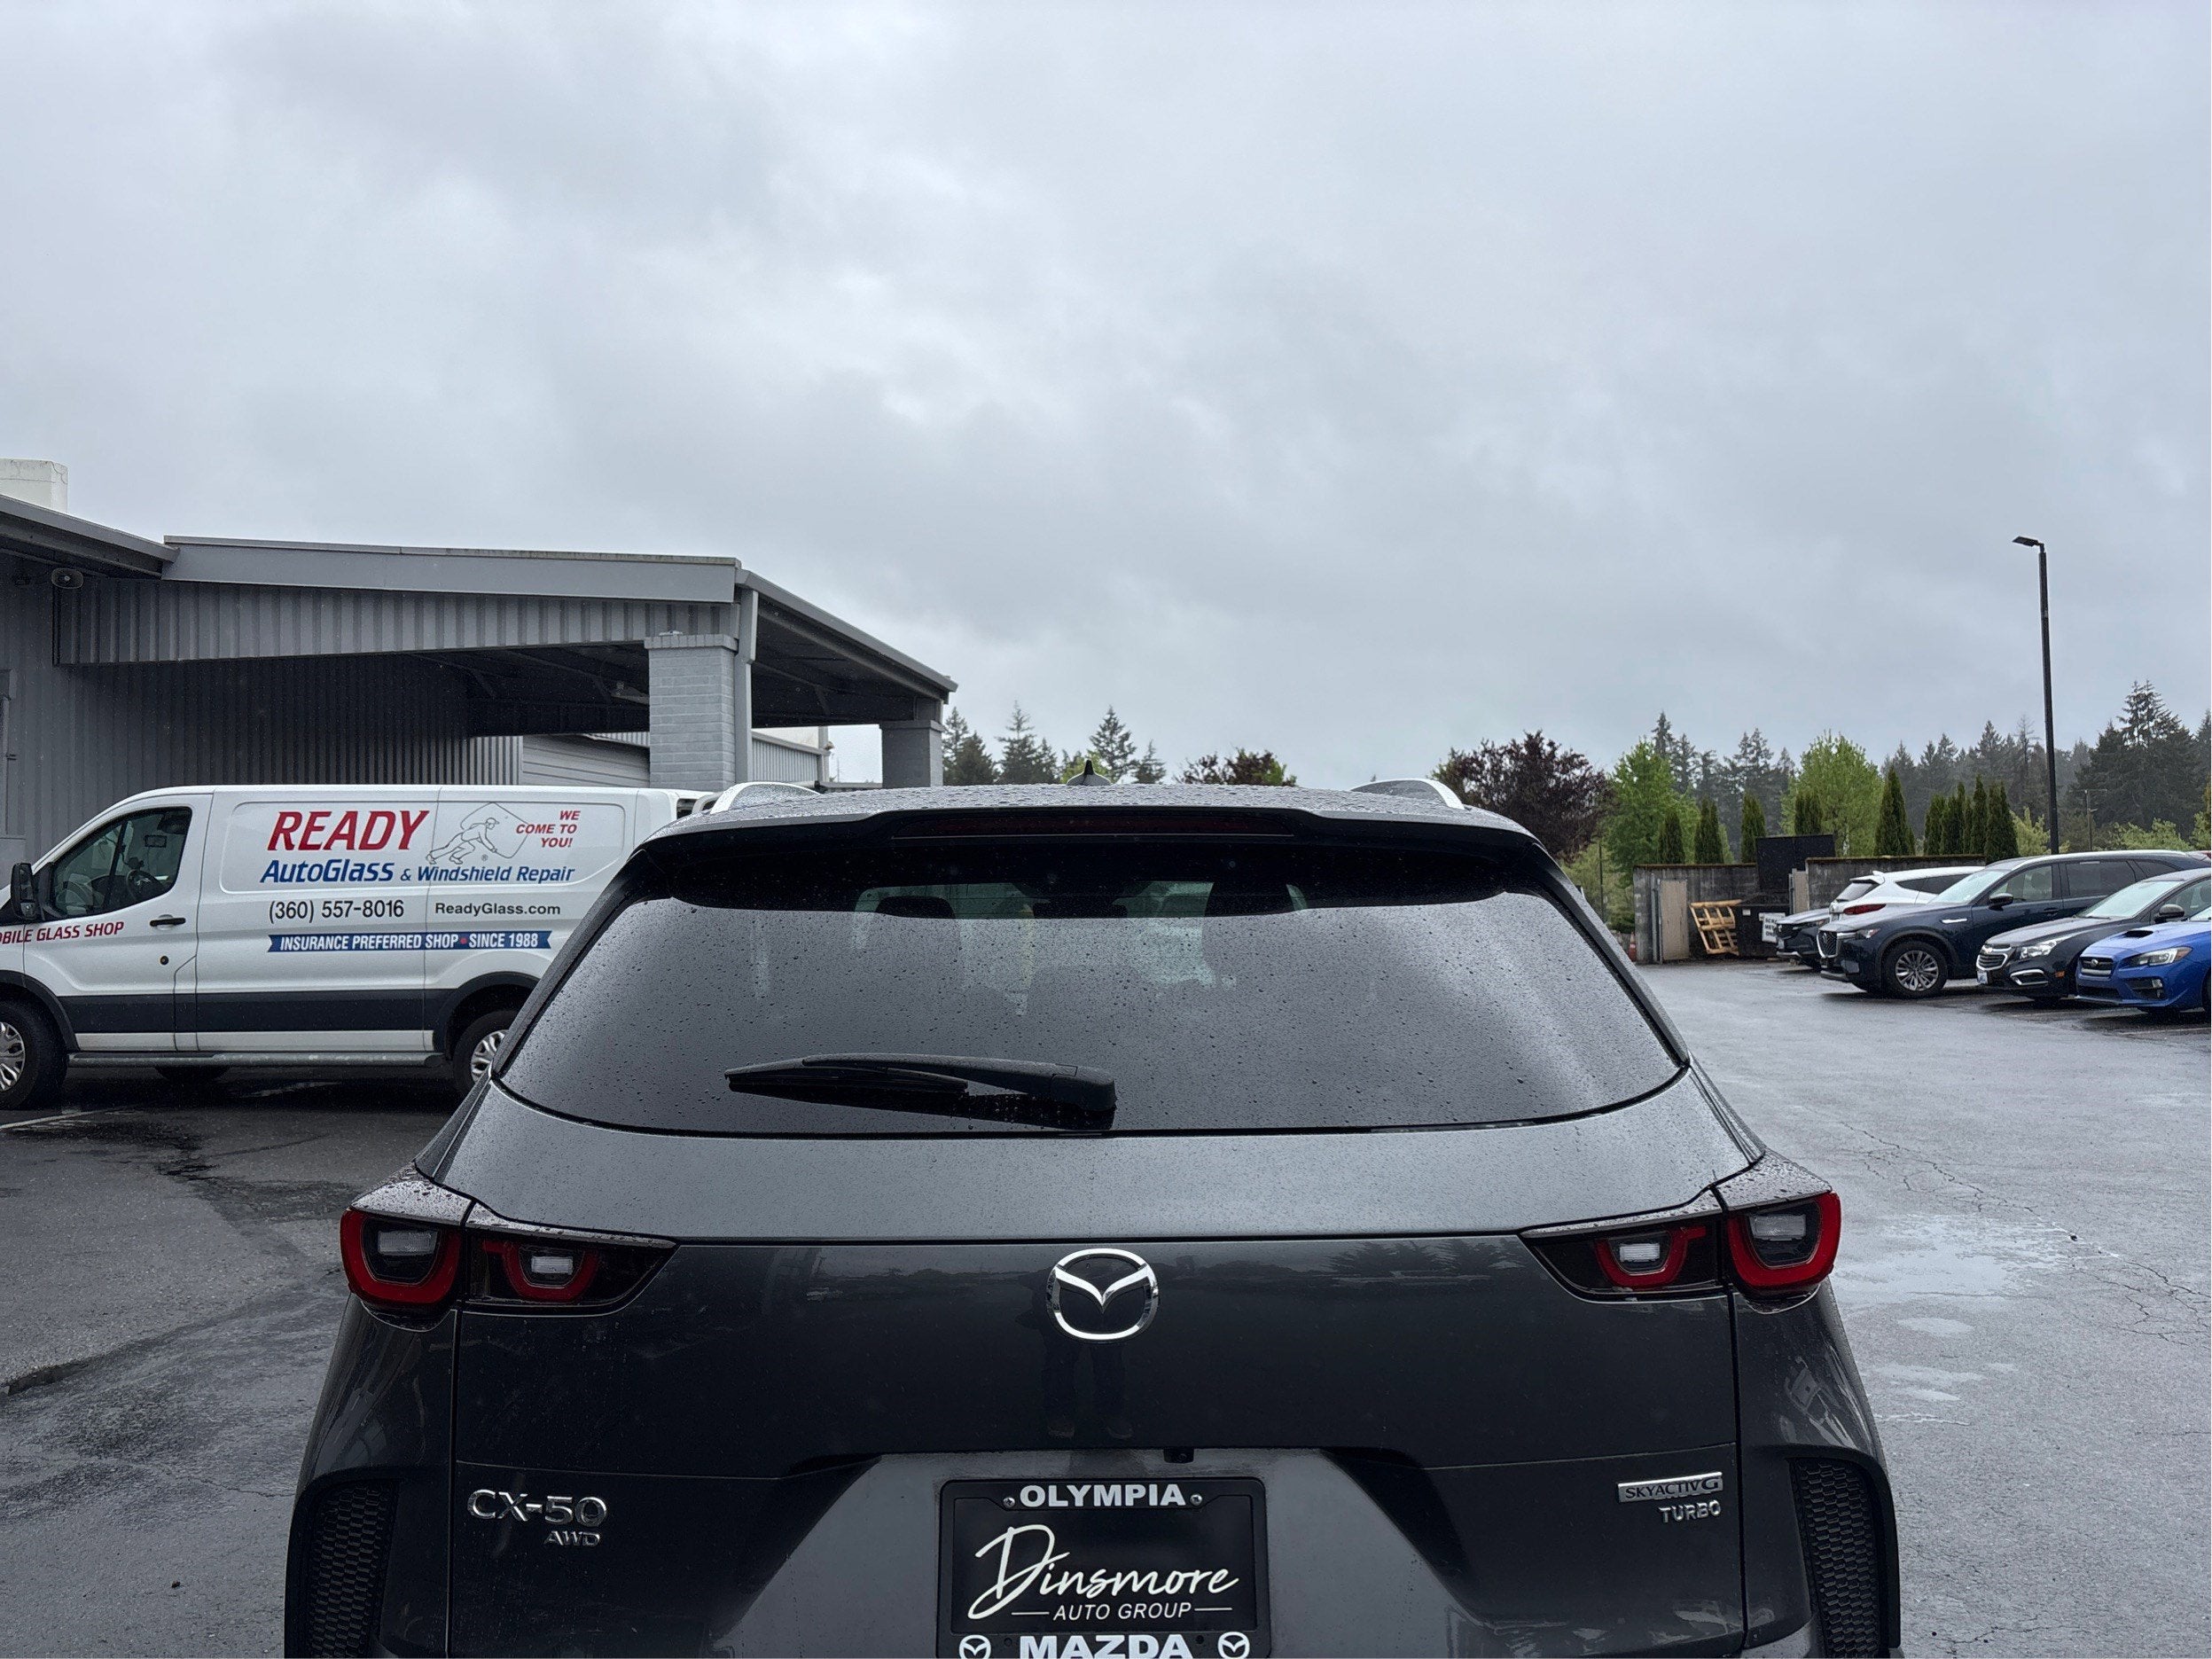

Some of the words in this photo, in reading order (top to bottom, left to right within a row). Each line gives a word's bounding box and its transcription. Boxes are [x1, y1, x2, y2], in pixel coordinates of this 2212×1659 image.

[559, 810, 580, 820] WE
[268, 810, 430, 851] READY
[516, 824, 556, 834] COME
[559, 824, 577, 833] TO
[541, 837, 573, 848] YOU!
[260, 858, 395, 883] AutoGlass
[400, 868, 411, 881] &
[418, 865, 512, 882] Windshield
[516, 866, 575, 884] Repair
[269, 900, 314, 924] (360)
[321, 900, 404, 919] 557-8016
[434, 903, 561, 917] ReadyGlass.com
[0, 929, 34, 944] BILE
[36, 925, 81, 942] GLASS
[84, 921, 124, 938] SHOP
[280, 935, 349, 951] INSURANCE
[352, 935, 422, 950] PREFERRED
[425, 934, 458, 949] SHOP
[469, 933, 504, 948] SINCE
[509, 933, 538, 948] 1988
[1020, 1483, 1186, 1508] OLYMPIA
[467, 1489, 607, 1527] CX-50
[1658, 1499, 1722, 1523] TURBO
[543, 1530, 601, 1546] AWD
[967, 1523, 1239, 1620] Dinsmore
[1053, 1604, 1111, 1621] AUTO
[1118, 1602, 1192, 1620] GROUP
[1020, 1633, 1194, 1659] MAZDA
